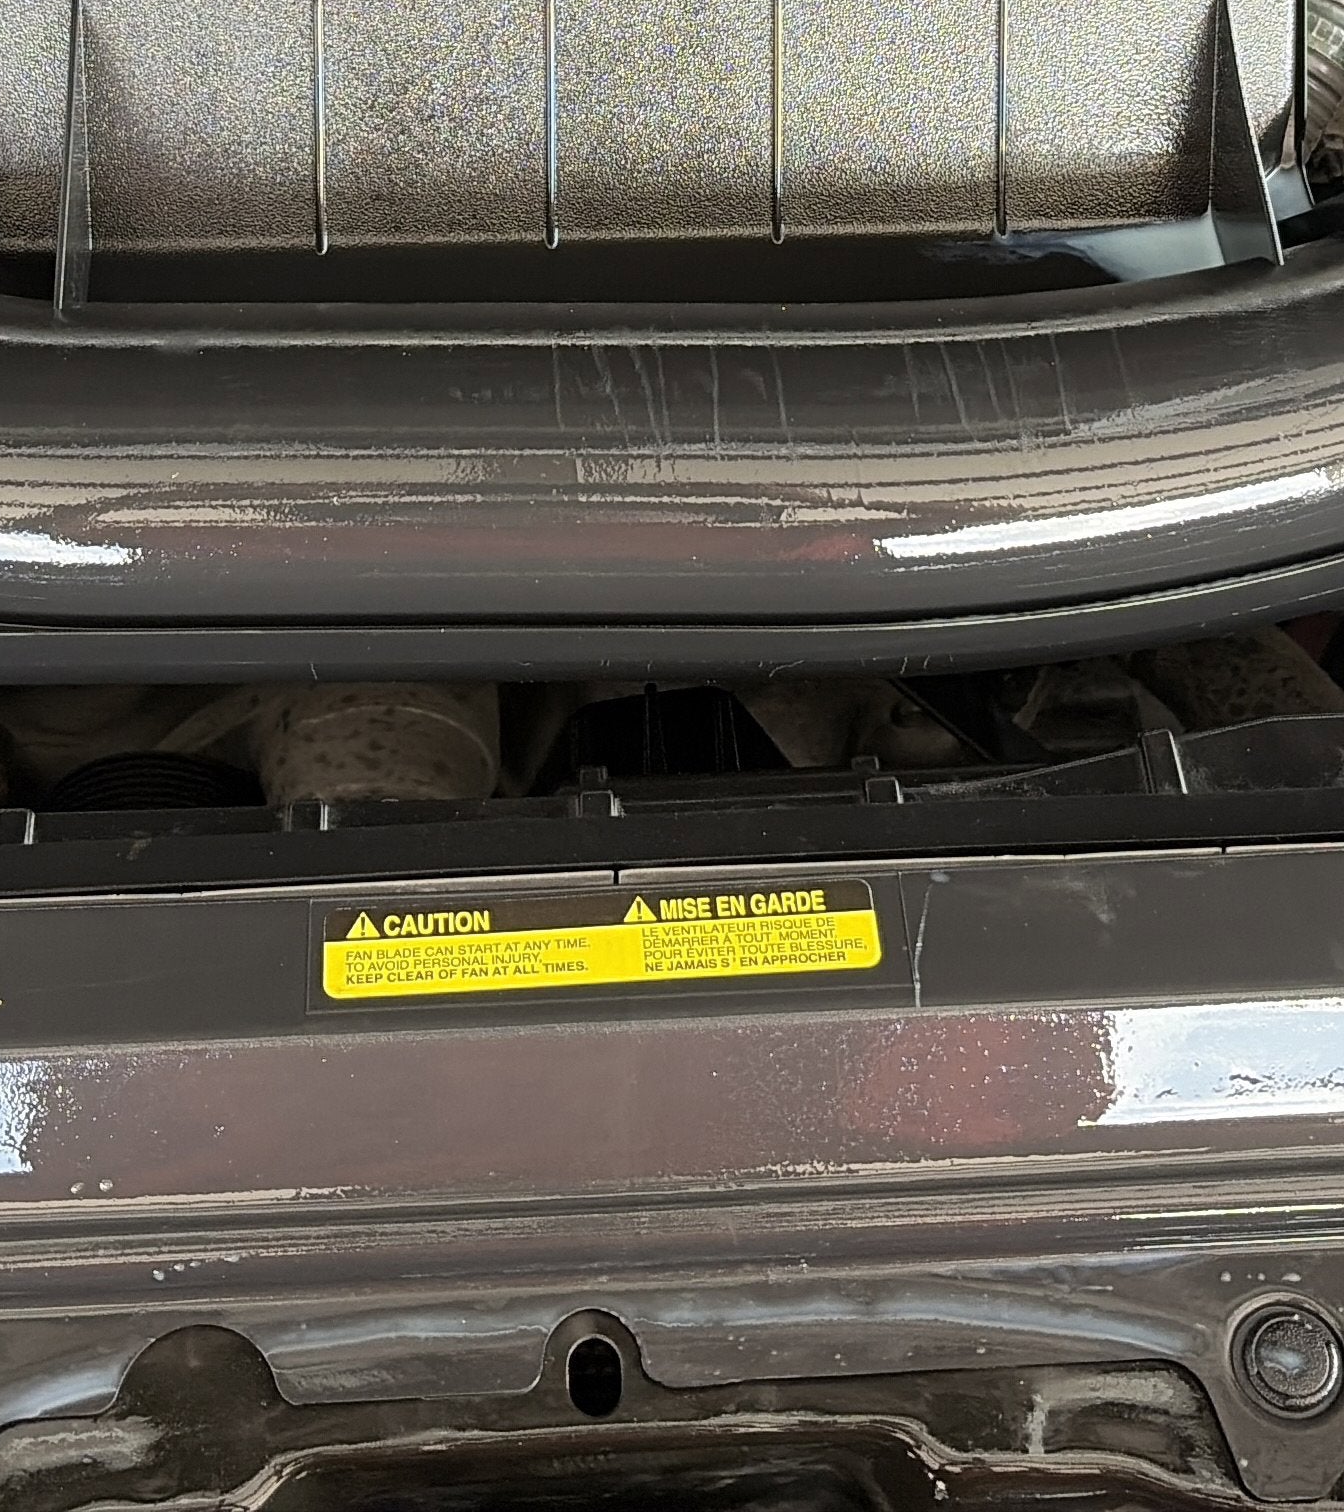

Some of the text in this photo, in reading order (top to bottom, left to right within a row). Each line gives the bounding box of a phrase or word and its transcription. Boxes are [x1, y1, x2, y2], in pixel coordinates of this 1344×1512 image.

[659, 889, 827, 921] MISE EN GARDE
[383, 910, 491, 936] CAUTION
[642, 916, 835, 937] LE VENTILATEUR RISQUE DE
[644, 949, 682, 960] POUR
[739, 942, 786, 955] TOUTE
[790, 937, 868, 952] BLESSURE,
[735, 931, 772, 943] TOUT
[345, 937, 591, 962] FAN BLADE CAN START AT ANY TIME.
[345, 962, 365, 973] TO
[368, 959, 410, 972] AVOID
[413, 956, 488, 969] PERSONAL
[346, 960, 589, 985] KEEP CLEAR OF FAN AT ALL TIMES.
[645, 961, 664, 972] NE
[666, 958, 718, 971] JAMAIS
[740, 956, 759, 967] EN
[761, 951, 846, 966] APPROCHER
